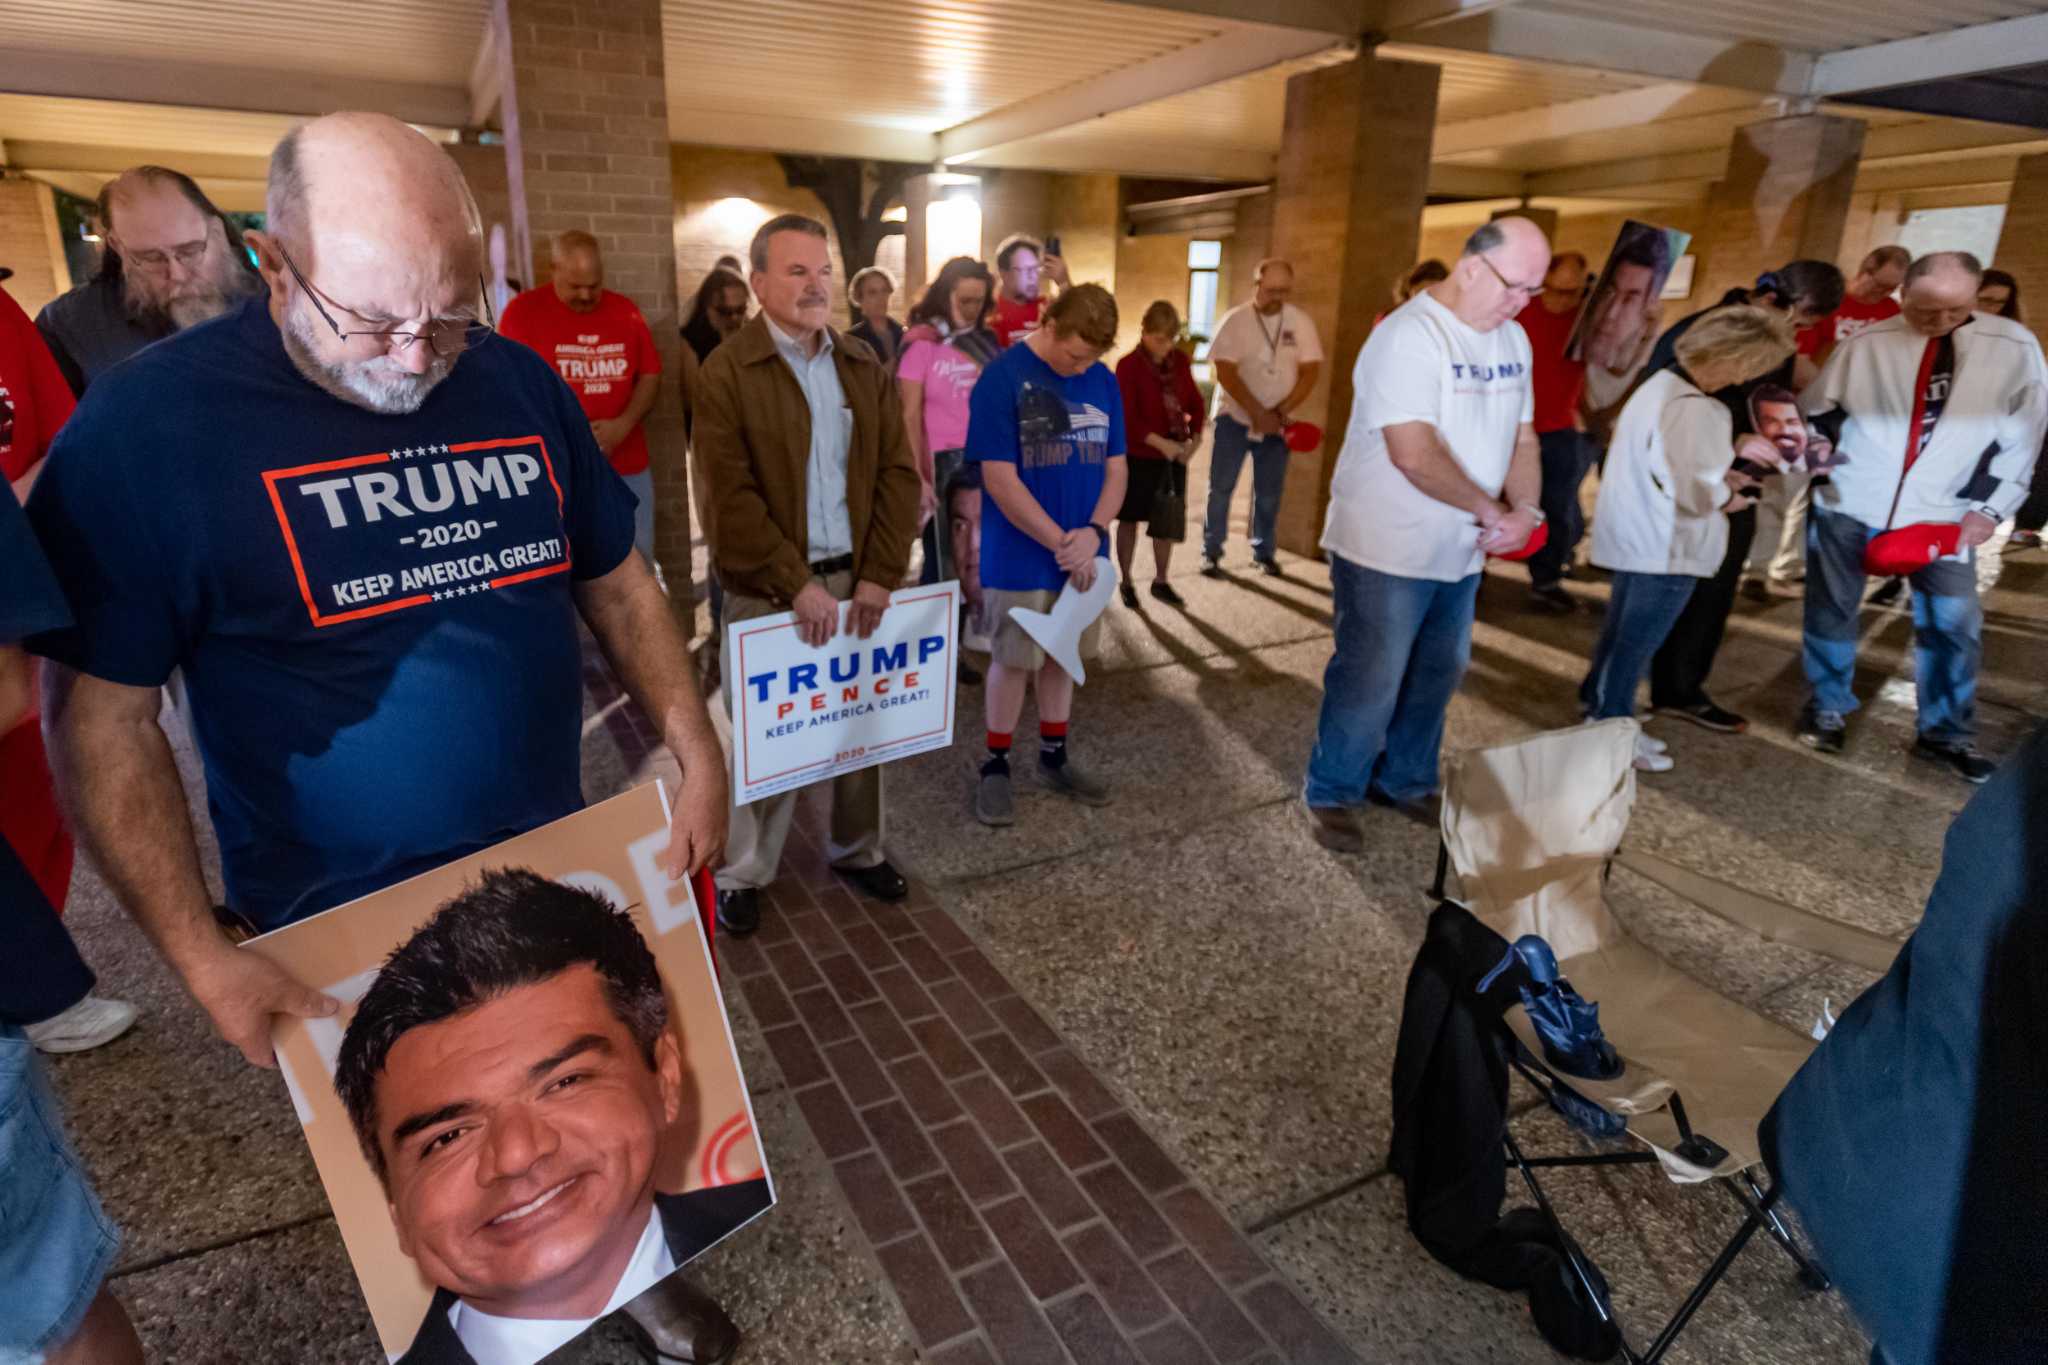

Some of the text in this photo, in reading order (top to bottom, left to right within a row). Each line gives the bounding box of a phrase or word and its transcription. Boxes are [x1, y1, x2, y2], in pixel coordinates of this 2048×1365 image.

[556, 358, 629, 379] TRUMP
[1452, 362, 1524, 382] TRUMP
[1022, 441, 1073, 468] RUMP
[299, 453, 541, 528] TRUMP
[332, 538, 562, 606] KEEP AMERICA GREAT!
[748, 635, 945, 704] TRUMP
[765, 689, 930, 740] KEEP AMERICA GREAT!
[777, 672, 920, 720] PENCE
[833, 746, 866, 763] 2020
